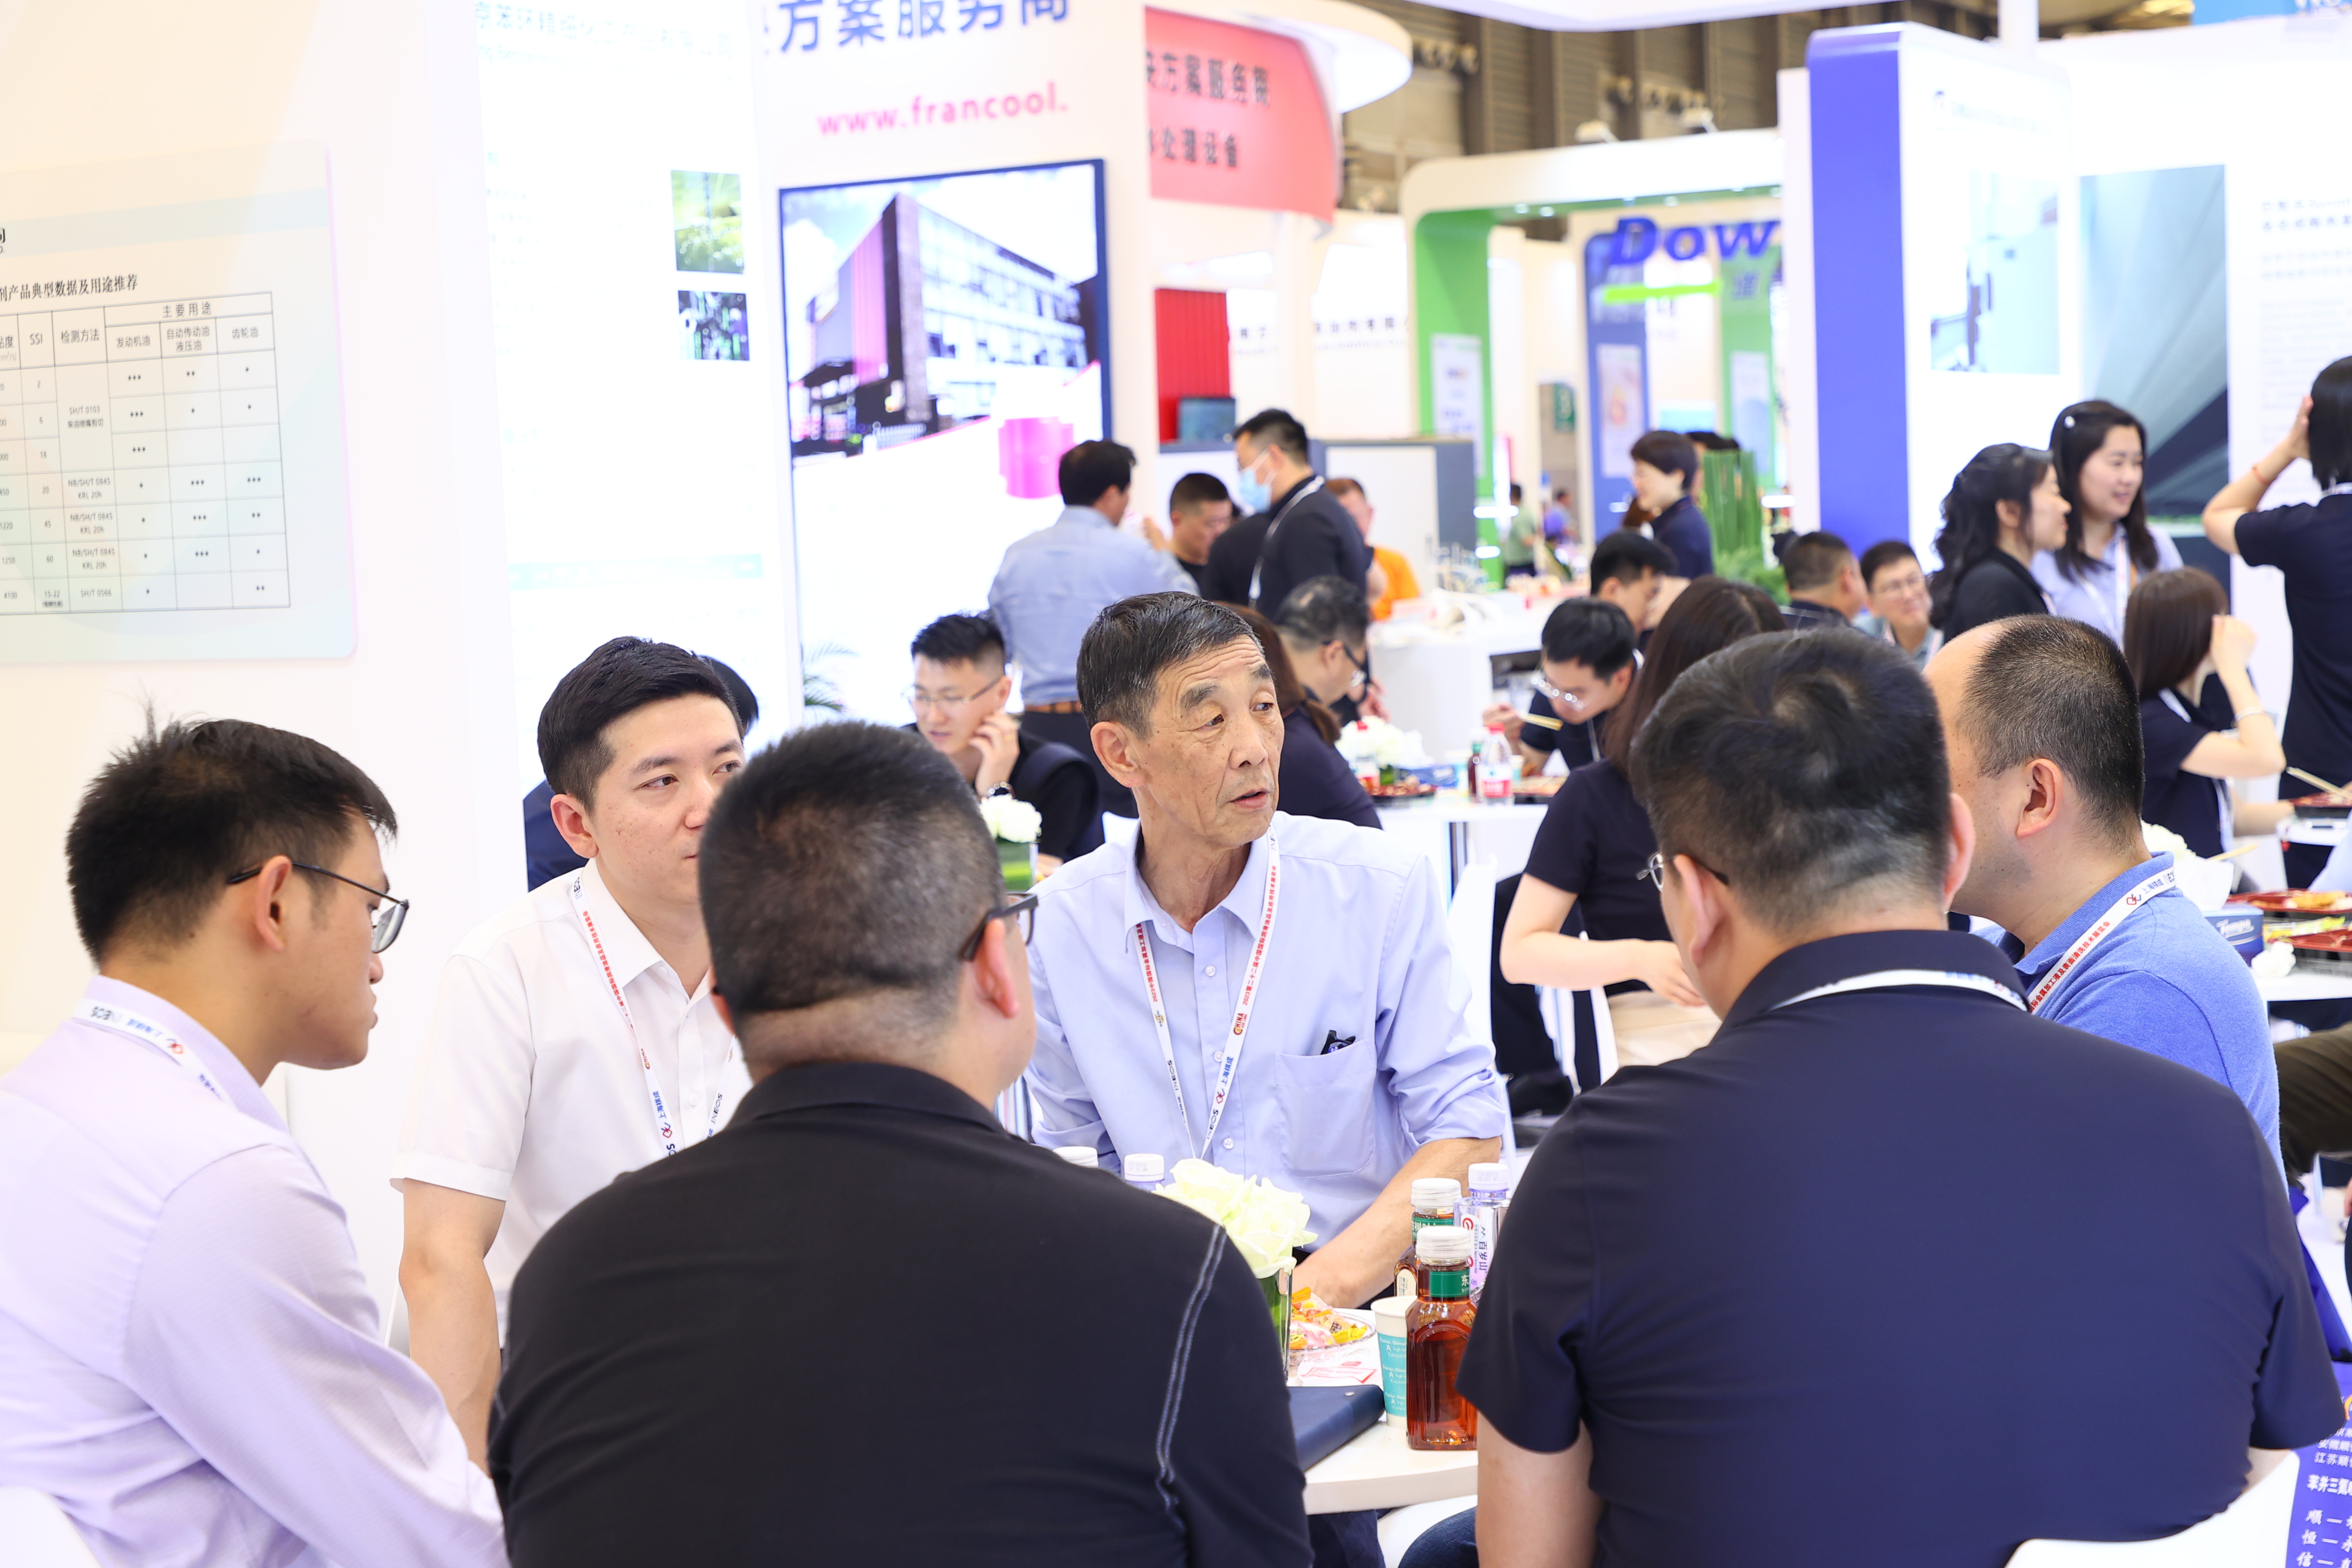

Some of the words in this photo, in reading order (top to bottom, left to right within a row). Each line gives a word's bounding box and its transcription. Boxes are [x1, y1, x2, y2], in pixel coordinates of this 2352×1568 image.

[162, 301, 211, 318] 主要用途
[30, 333, 43, 346] SSI
[60, 328, 100, 344] 检测方法
[166, 325, 210, 340] 自动传动油
[231, 327, 258, 340] 齿轮油
[116, 335, 150, 349] 发动机油
[176, 340, 202, 352] 液压油
[1233, 1013, 1244, 1035] CHINA
[710, 1093, 723, 1124] INEOS
[1207, 1109, 1219, 1139] INEOS
[1479, 1241, 1488, 1271] 百岁山
